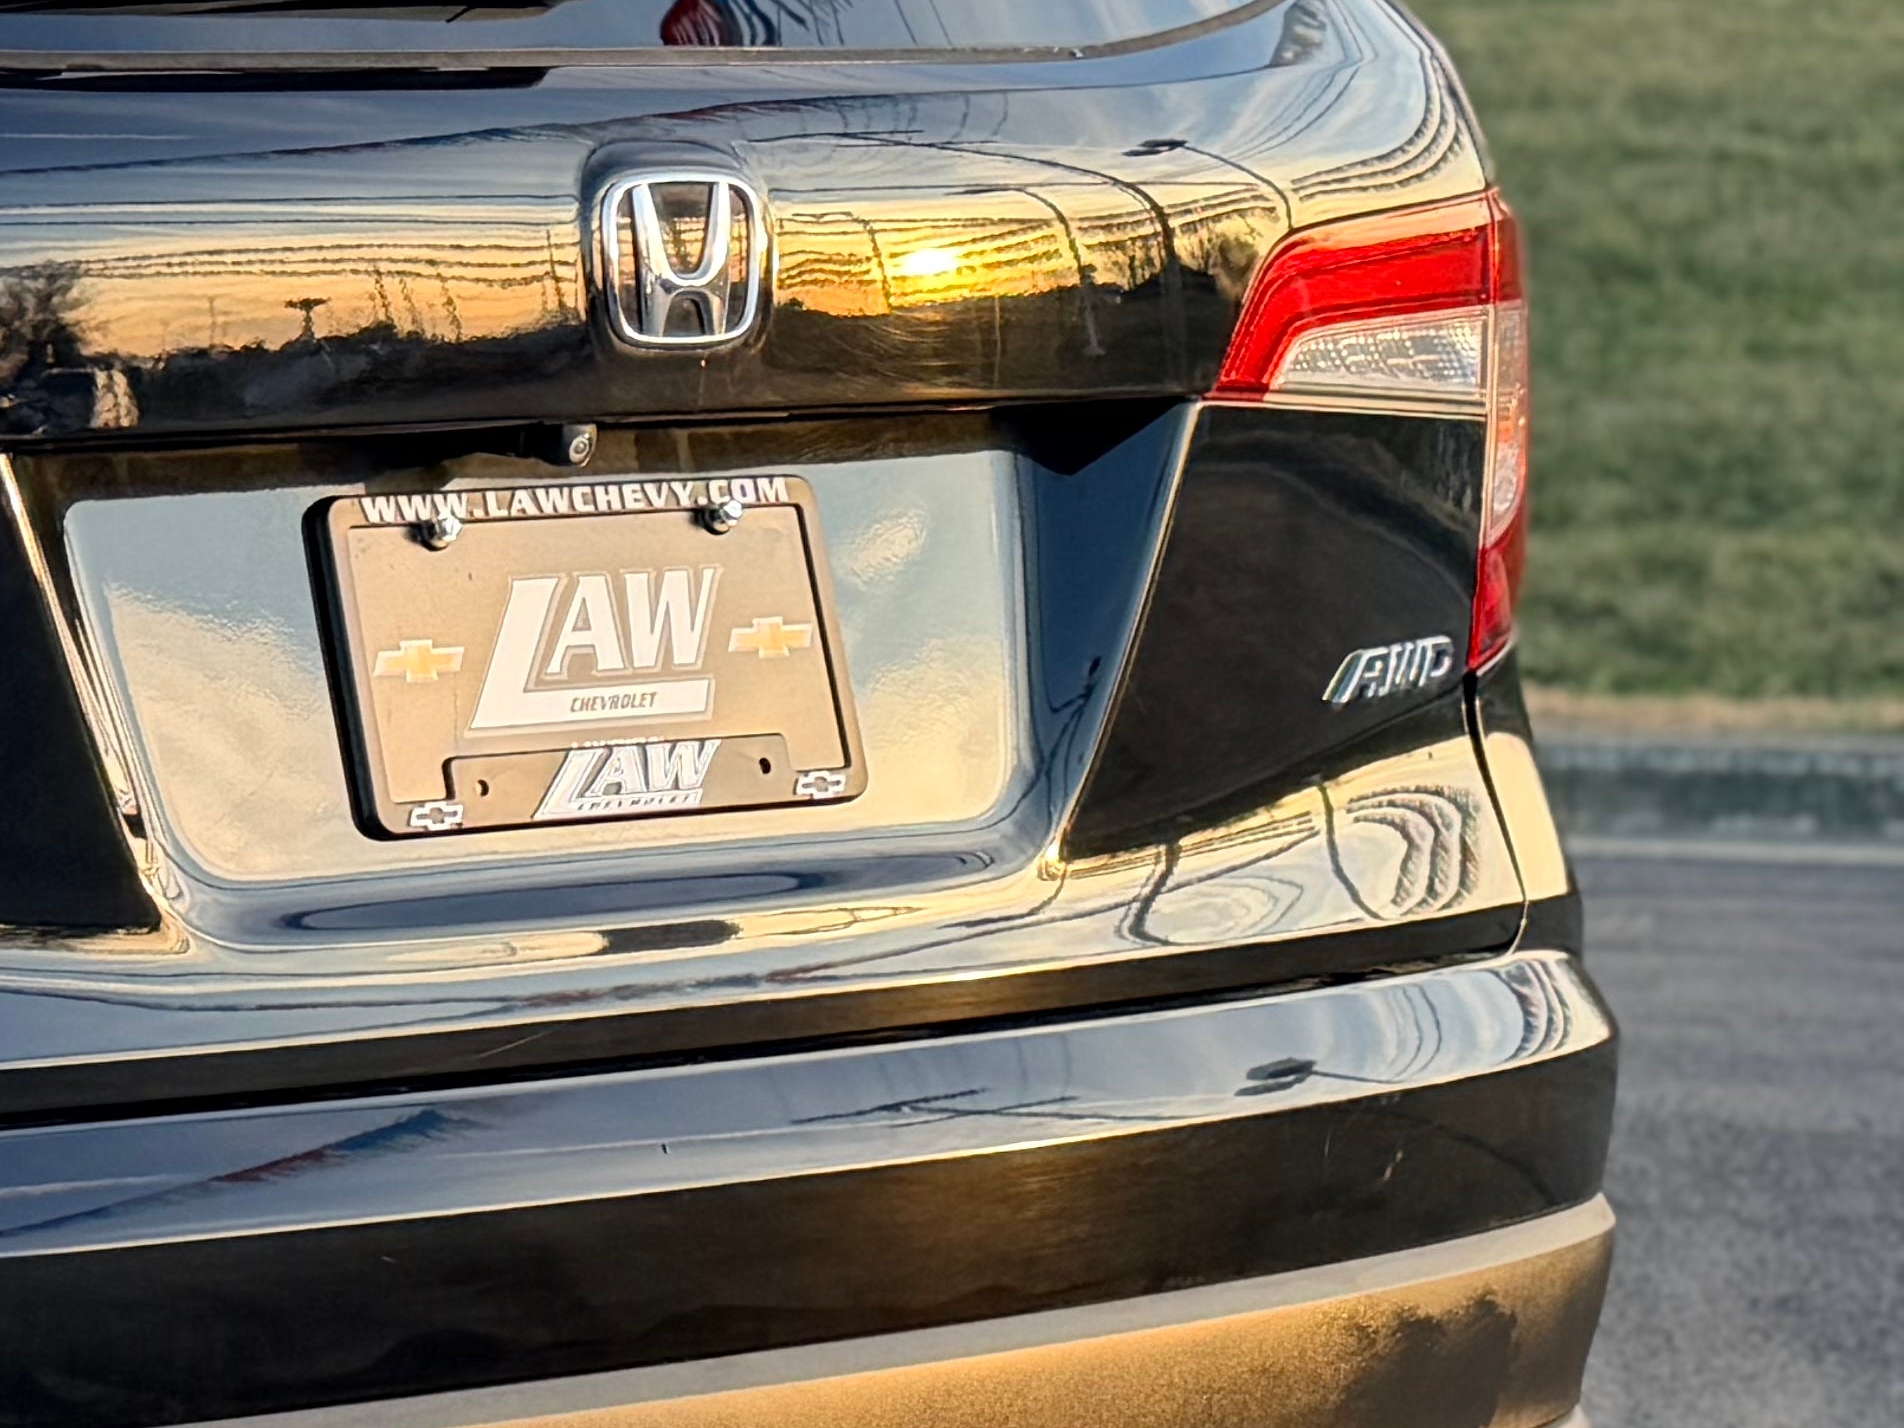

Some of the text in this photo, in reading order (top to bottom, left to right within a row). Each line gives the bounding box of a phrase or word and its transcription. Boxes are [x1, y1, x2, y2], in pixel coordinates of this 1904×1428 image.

[360, 476, 790, 524] WWW.LAWCHEVY.COM
[467, 566, 719, 733] LAW
[1322, 634, 1455, 704] AWD
[569, 691, 657, 713] CHEVROLET
[530, 738, 722, 822] LAW
